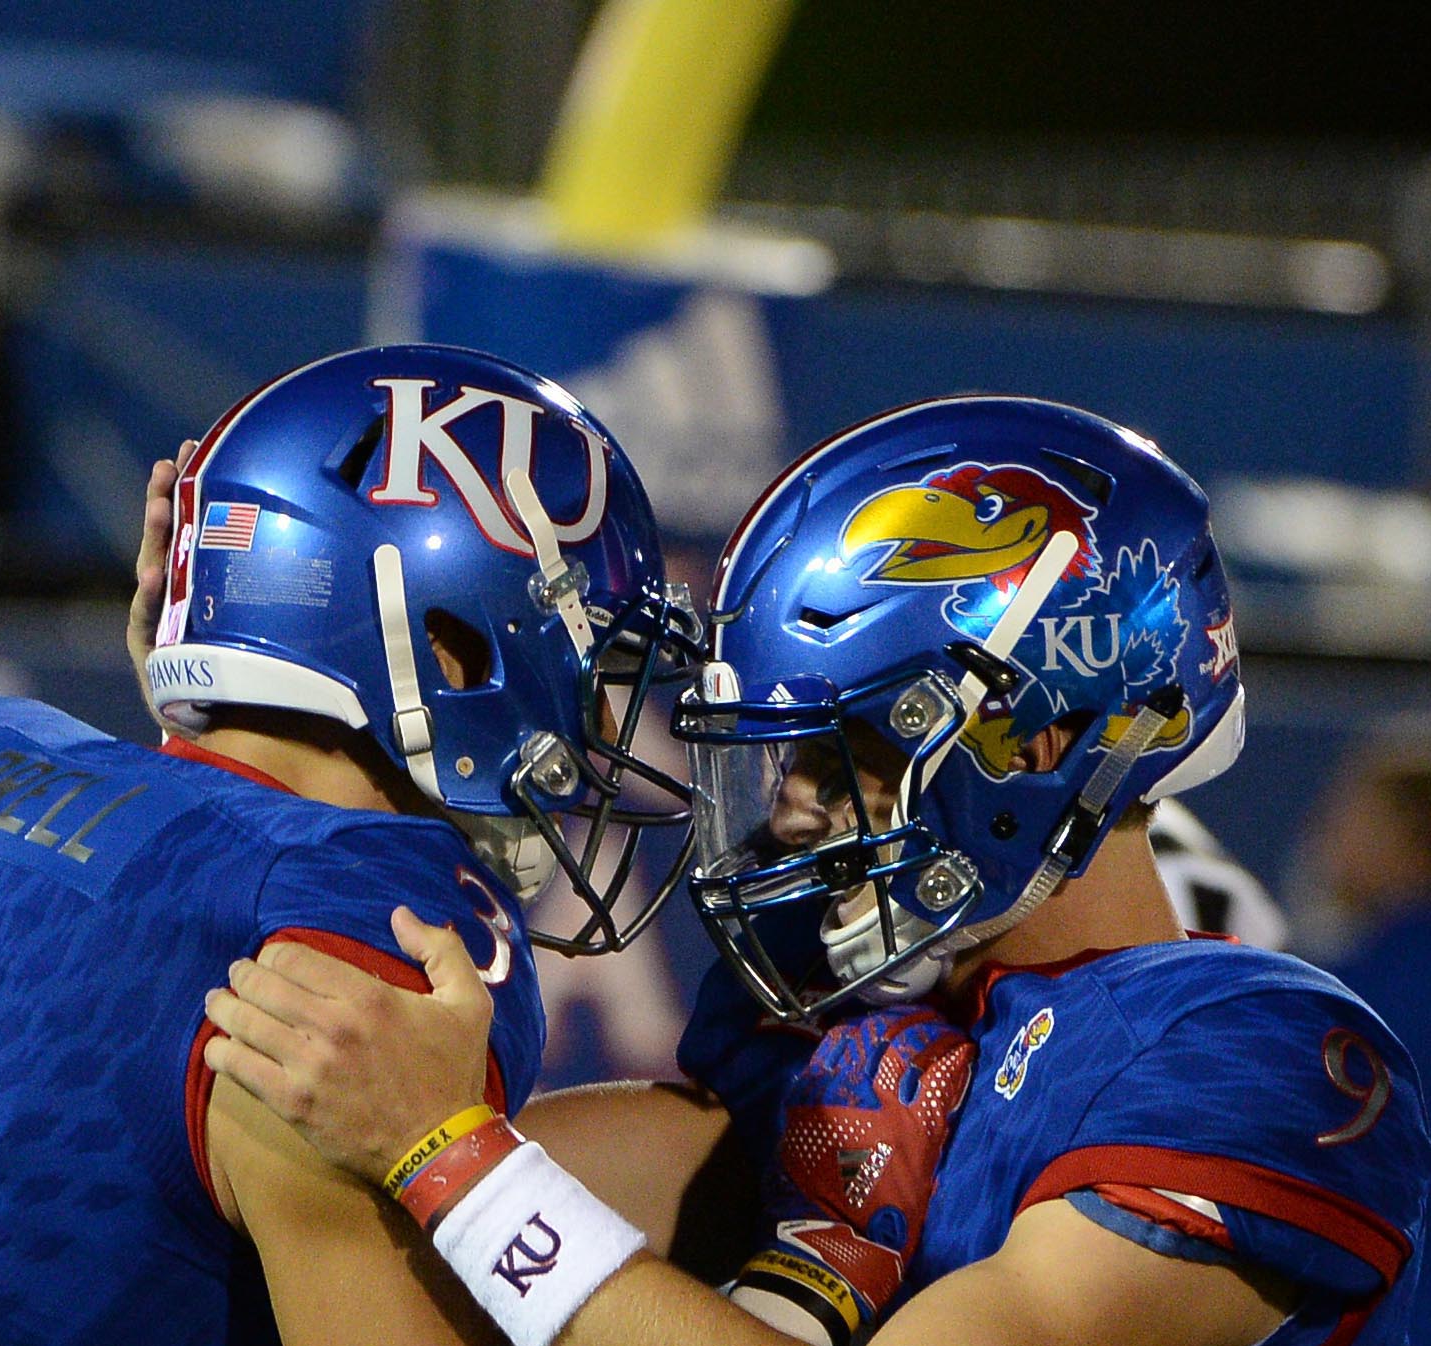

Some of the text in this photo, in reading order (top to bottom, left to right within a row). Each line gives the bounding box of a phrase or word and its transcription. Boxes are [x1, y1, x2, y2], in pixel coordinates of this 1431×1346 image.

[368, 376, 611, 559] KU
[203, 595, 215, 621] 3
[1037, 613, 1122, 677] KU
[443, 863, 514, 988] 3
[1315, 1027, 1393, 1149] 9
[491, 1211, 562, 1298] KU
